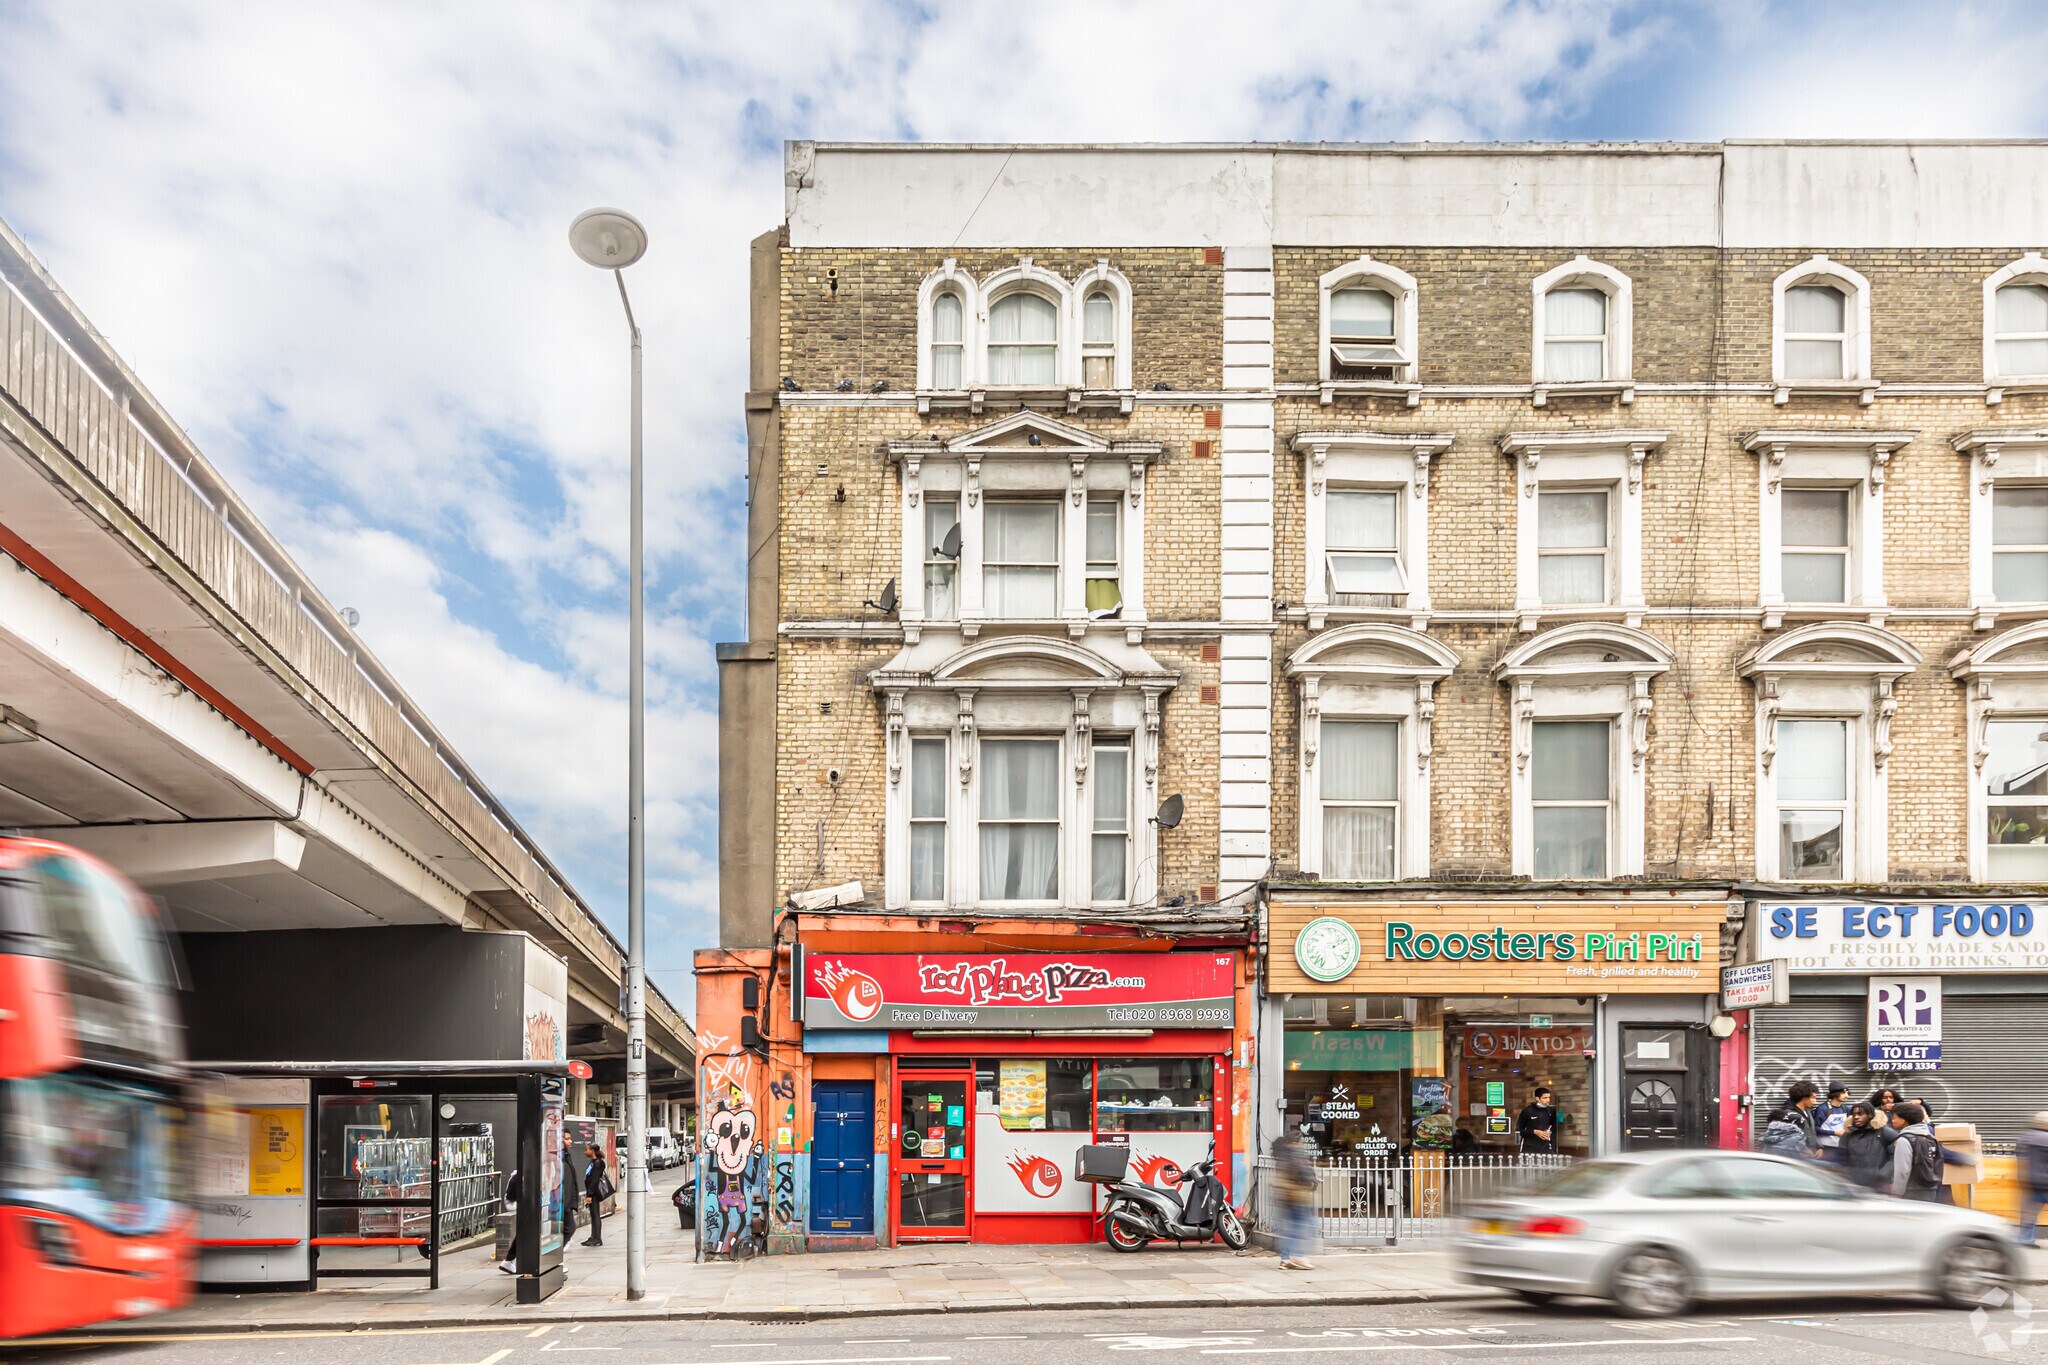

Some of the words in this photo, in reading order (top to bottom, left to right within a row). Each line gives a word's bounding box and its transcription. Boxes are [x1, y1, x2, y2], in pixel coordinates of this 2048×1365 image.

[1933, 904, 2034, 938] FOOD
[1386, 921, 1576, 960] Roosters
[1584, 932, 1640, 960] Piri
[1646, 932, 1702, 960] Piri
[1829, 943, 1918, 955] FRESHLY
[1926, 942, 1983, 954] MADE
[1215, 957, 1230, 966] 167
[1789, 956, 1830, 968] HOT
[1844, 956, 1857, 968] &
[1866, 955, 1921, 968] COLD
[1930, 955, 2012, 967] DRINKS,
[1566, 965, 1598, 977] Fresh,
[1601, 965, 1635, 978] grilled
[1637, 965, 1659, 976] and
[1661, 965, 1700, 978] healthy
[1724, 969, 1738, 978] OFF
[1740, 964, 1771, 976] LICENCE
[921, 962, 969, 994] red
[1724, 972, 1772, 987] SANDWICHES
[1725, 987, 1746, 997] TAKE
[1748, 984, 1771, 994] AWAY
[1737, 994, 1759, 1003] FOOD
[892, 1010, 920, 1021] Free
[924, 1009, 978, 1024] Delivery
[1107, 1008, 1156, 1020] Tel:020
[1160, 1008, 1193, 1020] 8968
[1197, 1008, 1230, 1020] 9998
[1882, 1047, 1901, 1058] TO
[1904, 1047, 1928, 1058] LET
[1872, 1062, 1889, 1070] 020
[1891, 1062, 1913, 1070] 7368
[1915, 1062, 1937, 1070] 3336
[1325, 1102, 1356, 1111] STEAM
[1321, 1111, 1360, 1119] COOKED
